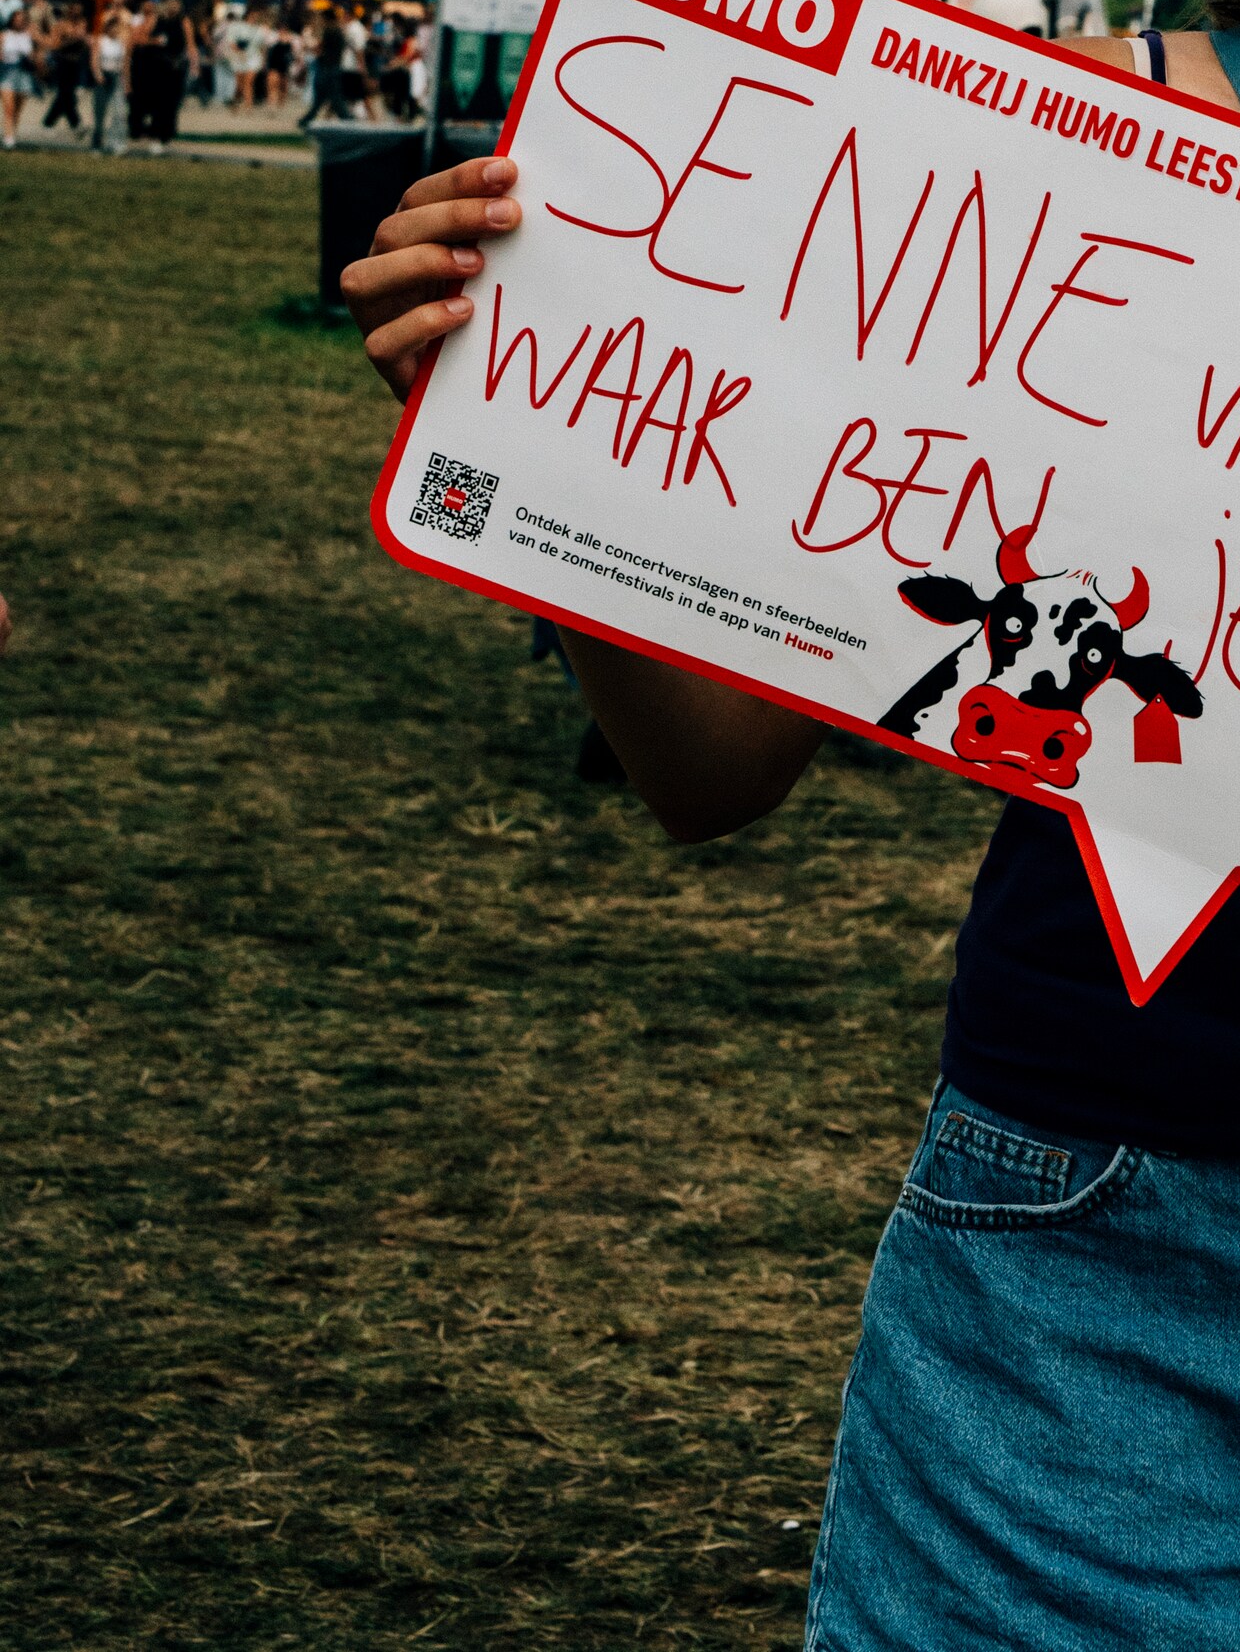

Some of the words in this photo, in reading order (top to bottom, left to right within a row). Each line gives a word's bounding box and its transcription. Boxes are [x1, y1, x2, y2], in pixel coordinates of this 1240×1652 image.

[870, 26, 1029, 117] DANKZIJ
[1030, 86, 1141, 159] HUMO
[544, 35, 1195, 427] SENNE
[485, 283, 753, 507] WAAR
[791, 416, 1056, 568] BEN
[508, 529, 536, 549] van
[539, 540, 559, 557] de
[561, 550, 675, 603] zomerfestivals
[678, 592, 693, 609] in
[696, 600, 716, 617] de
[719, 610, 749, 631] app
[753, 622, 781, 641] van
[784, 631, 834, 661] Humo
[515, 506, 572, 539] Ontdek
[574, 532, 602, 551] alle
[604, 544, 739, 603] concertverslagen
[742, 595, 762, 611] en
[765, 605, 868, 651] sfeerbeelden
